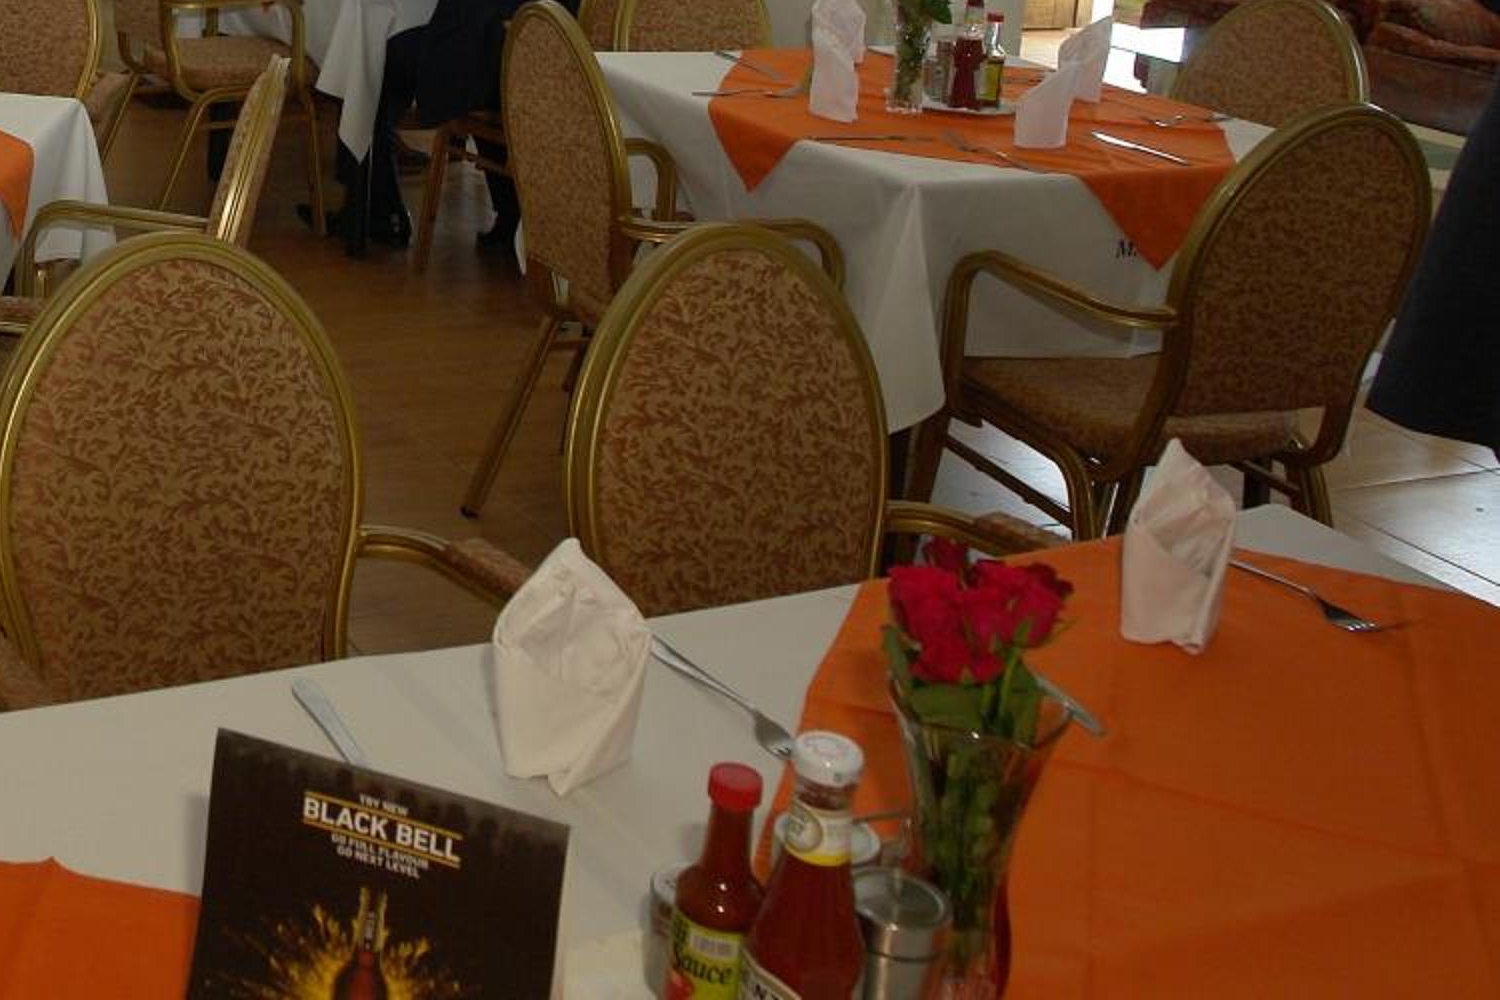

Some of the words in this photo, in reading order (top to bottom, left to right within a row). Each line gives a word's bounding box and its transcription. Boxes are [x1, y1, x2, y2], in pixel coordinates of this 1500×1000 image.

[360, 793, 381, 808] TRY
[383, 800, 409, 816] NEW
[303, 797, 389, 840] BLACK
[395, 823, 461, 863] BELL
[337, 845, 353, 858] GO
[355, 850, 384, 867] NEXT
[386, 858, 421, 879] LEVEL
[349, 836, 376, 854] FULL
[378, 845, 429, 869] FLAVOUR
